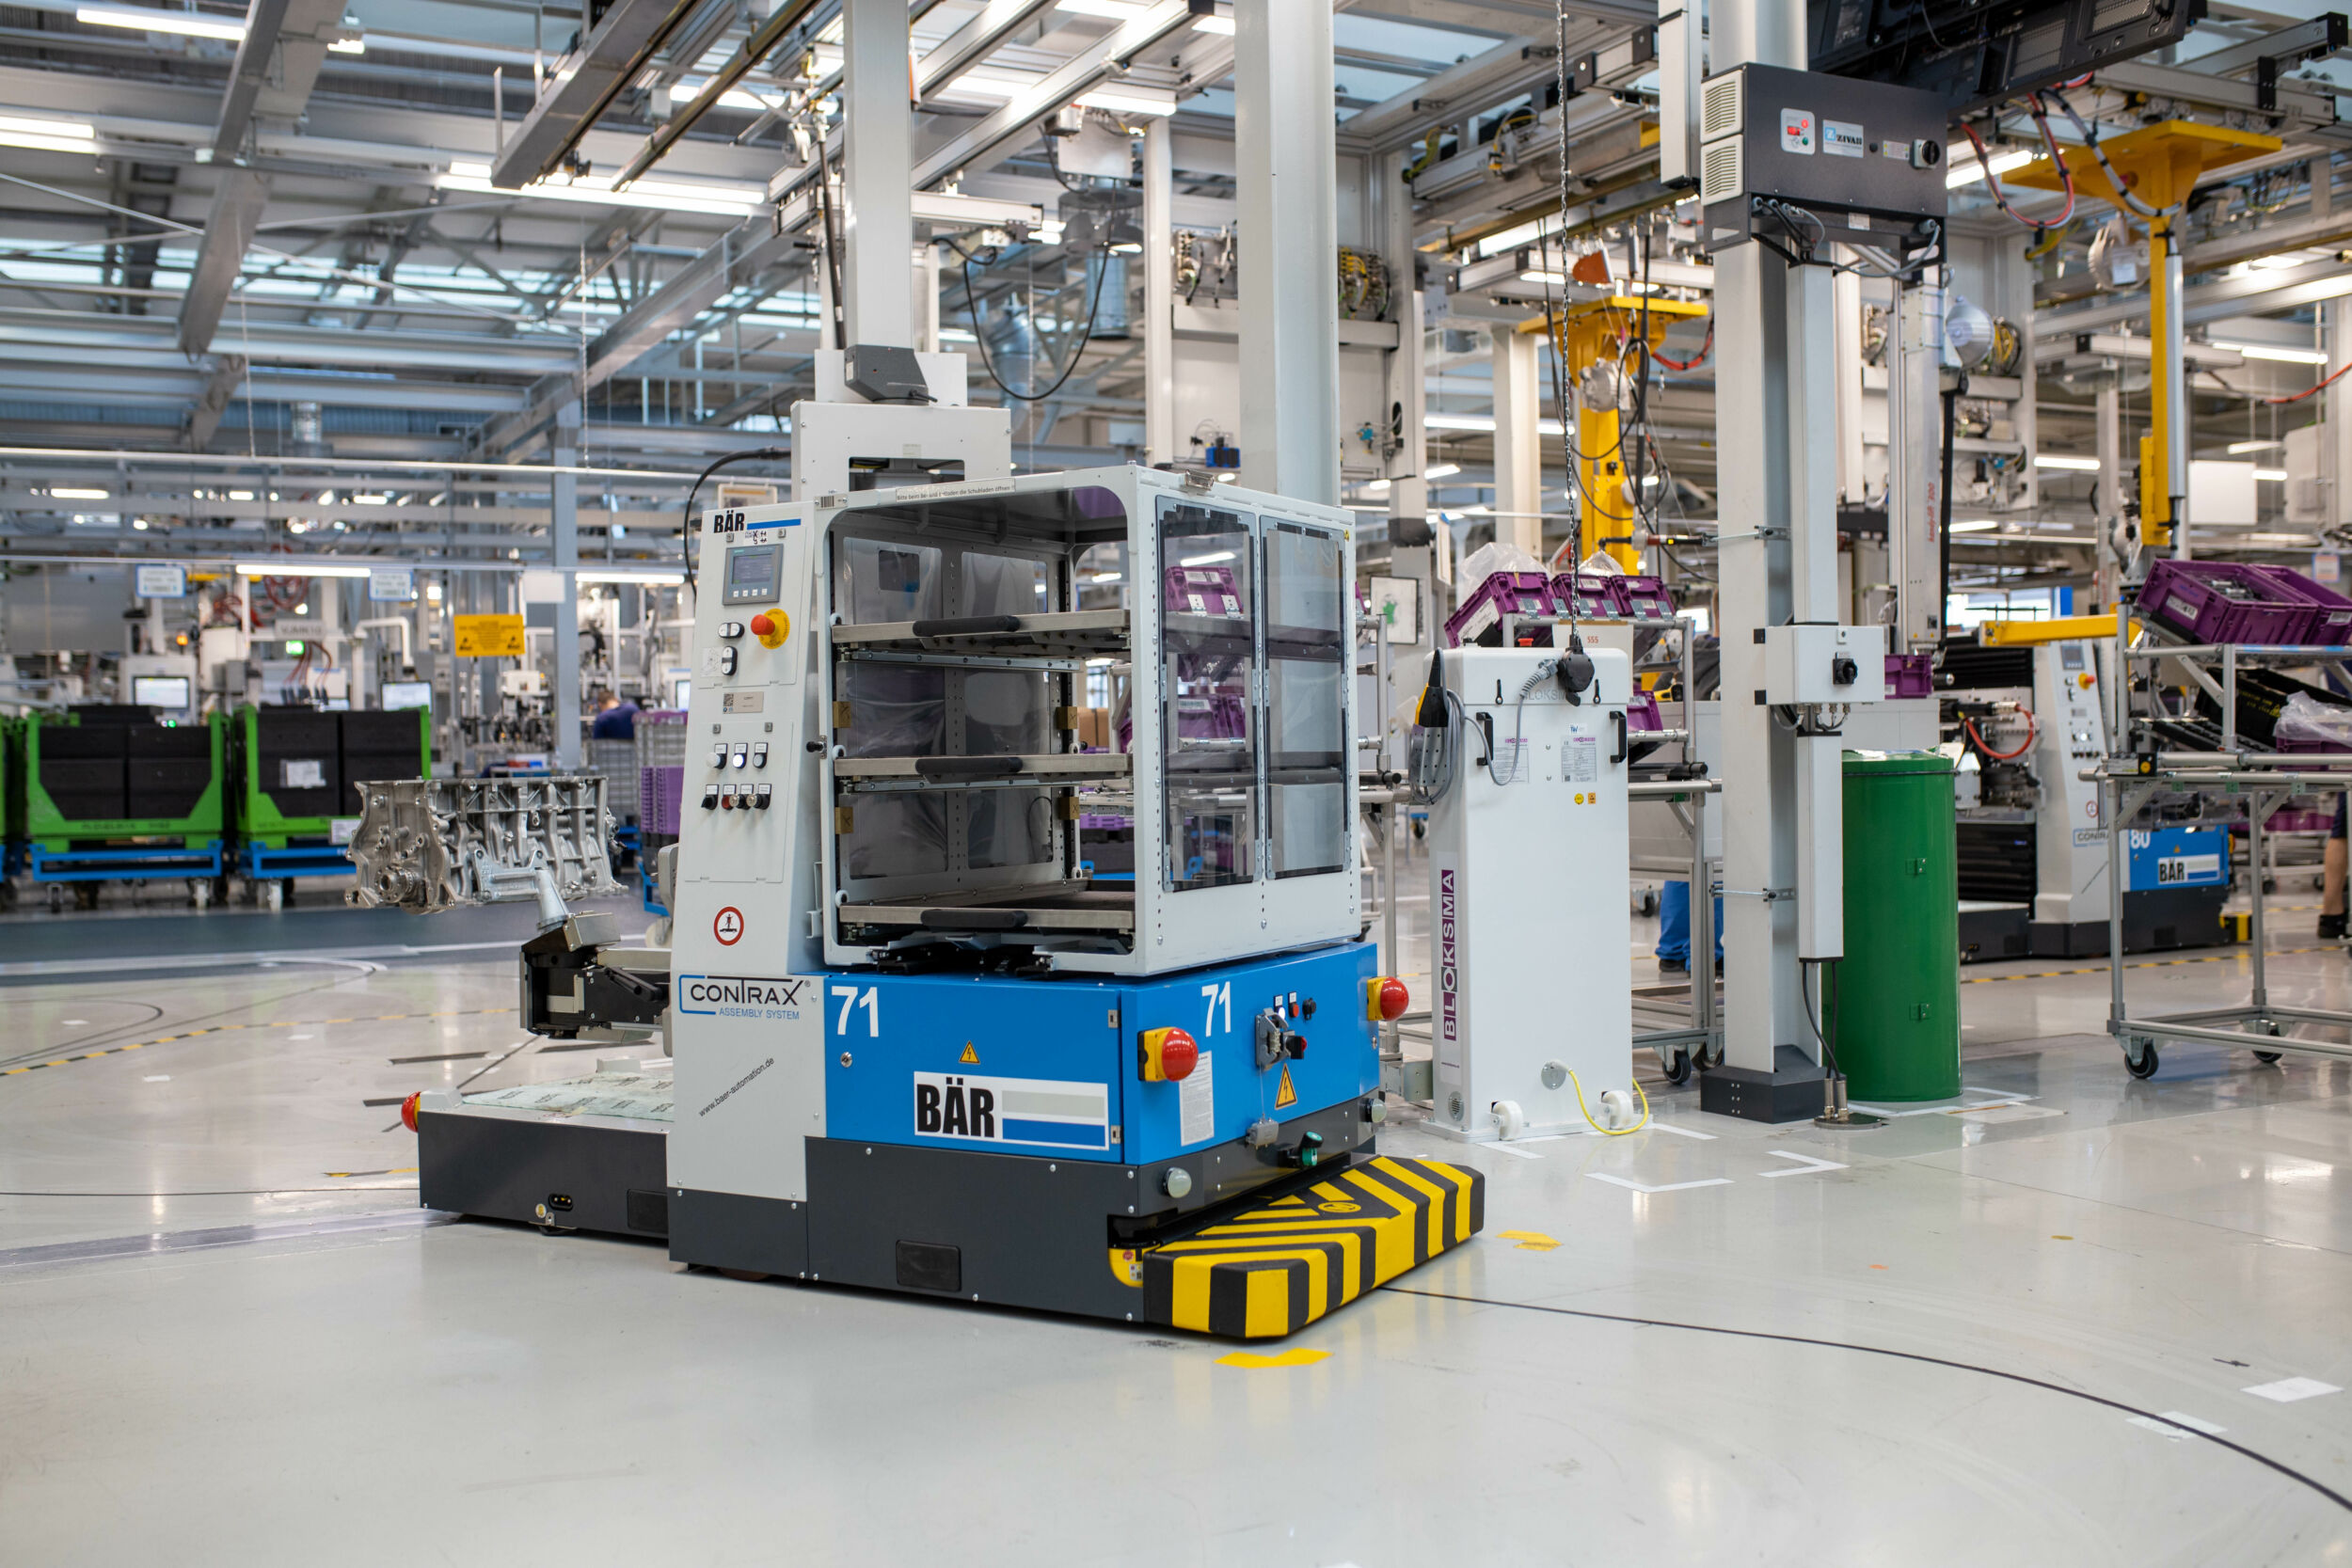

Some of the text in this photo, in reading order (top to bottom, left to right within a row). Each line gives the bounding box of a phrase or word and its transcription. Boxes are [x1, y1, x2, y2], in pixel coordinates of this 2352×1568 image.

[714, 510, 745, 533] BÄR
[2131, 829, 2151, 849] 80
[2159, 858, 2185, 882] BÄR
[1441, 871, 1456, 1038] BLOKSMA
[719, 1007, 800, 1020] ASSEMBLY SYSTEM
[831, 986, 879, 1037] 71
[1201, 981, 1231, 1037] 71
[698, 1057, 774, 1117] www.baer-automation.de
[916, 1077, 994, 1138] BÄR
